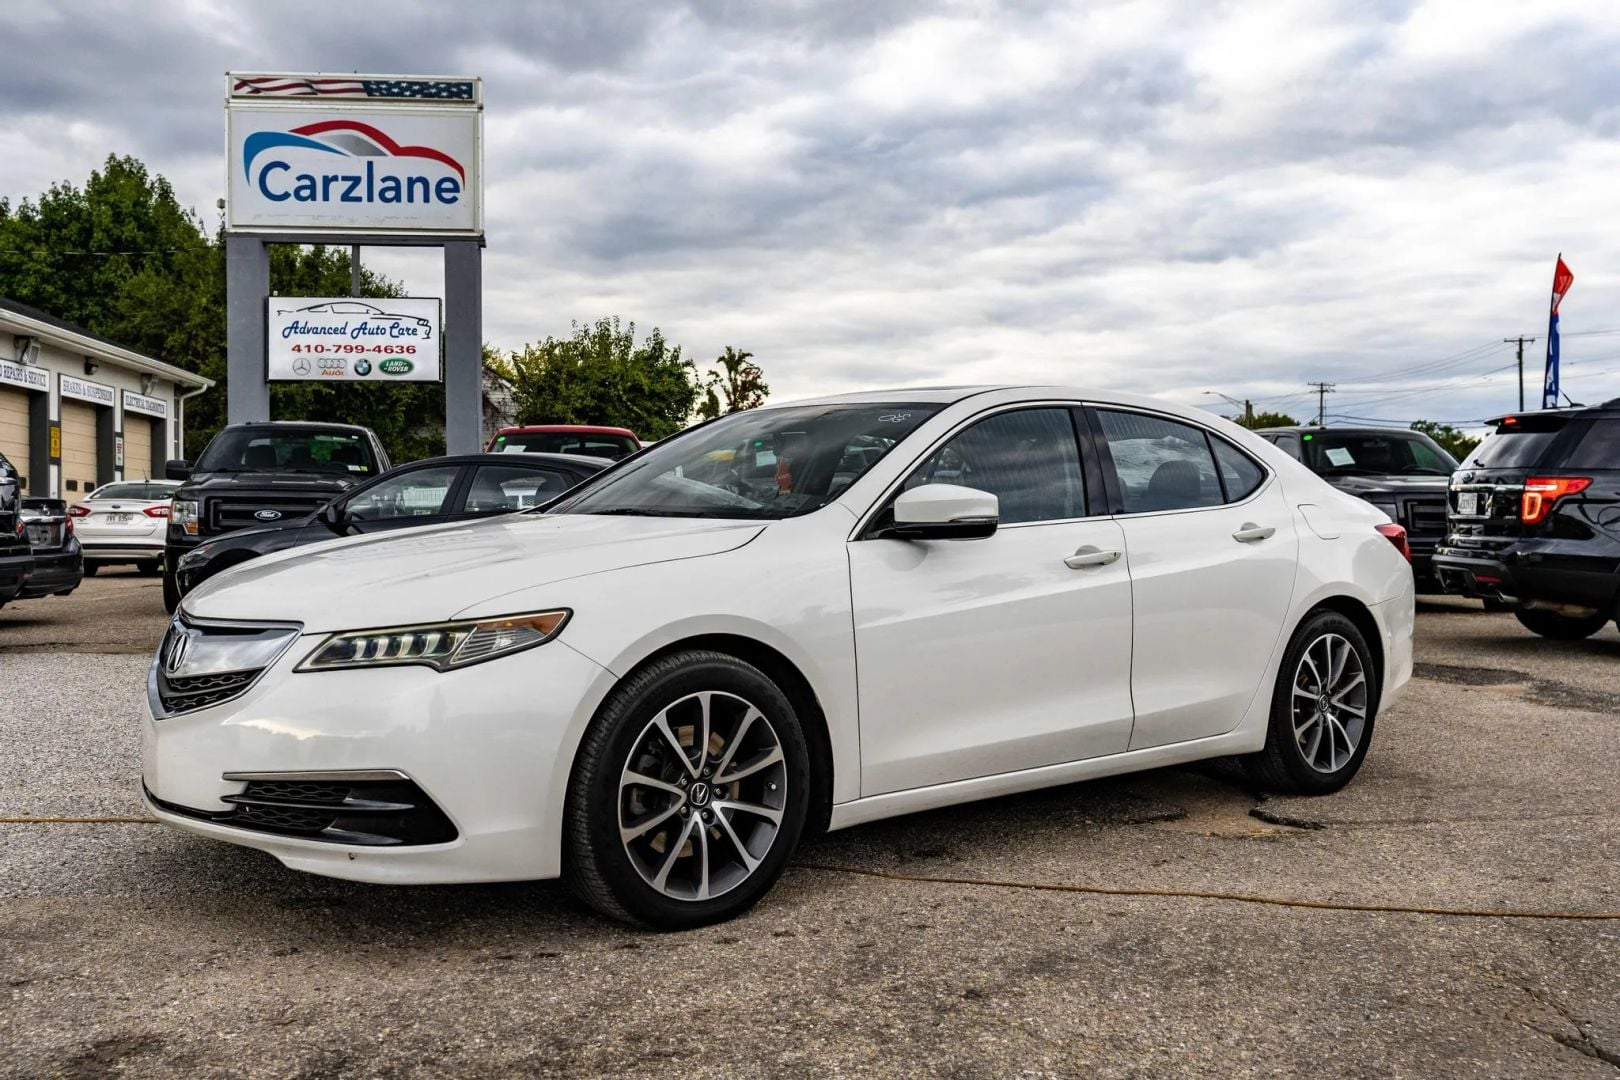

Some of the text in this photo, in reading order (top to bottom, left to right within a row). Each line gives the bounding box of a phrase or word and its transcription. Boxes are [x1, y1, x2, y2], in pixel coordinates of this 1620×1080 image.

[258, 160, 460, 205] Carzlane
[282, 320, 418, 340] Advanced Auto Care
[291, 344, 417, 355] 410-799-4636
[3, 364, 23, 382] REPAIRS
[28, 370, 47, 388] SERVICE
[63, 379, 82, 395] BRAKES
[86, 385, 113, 402] SUSPENSION
